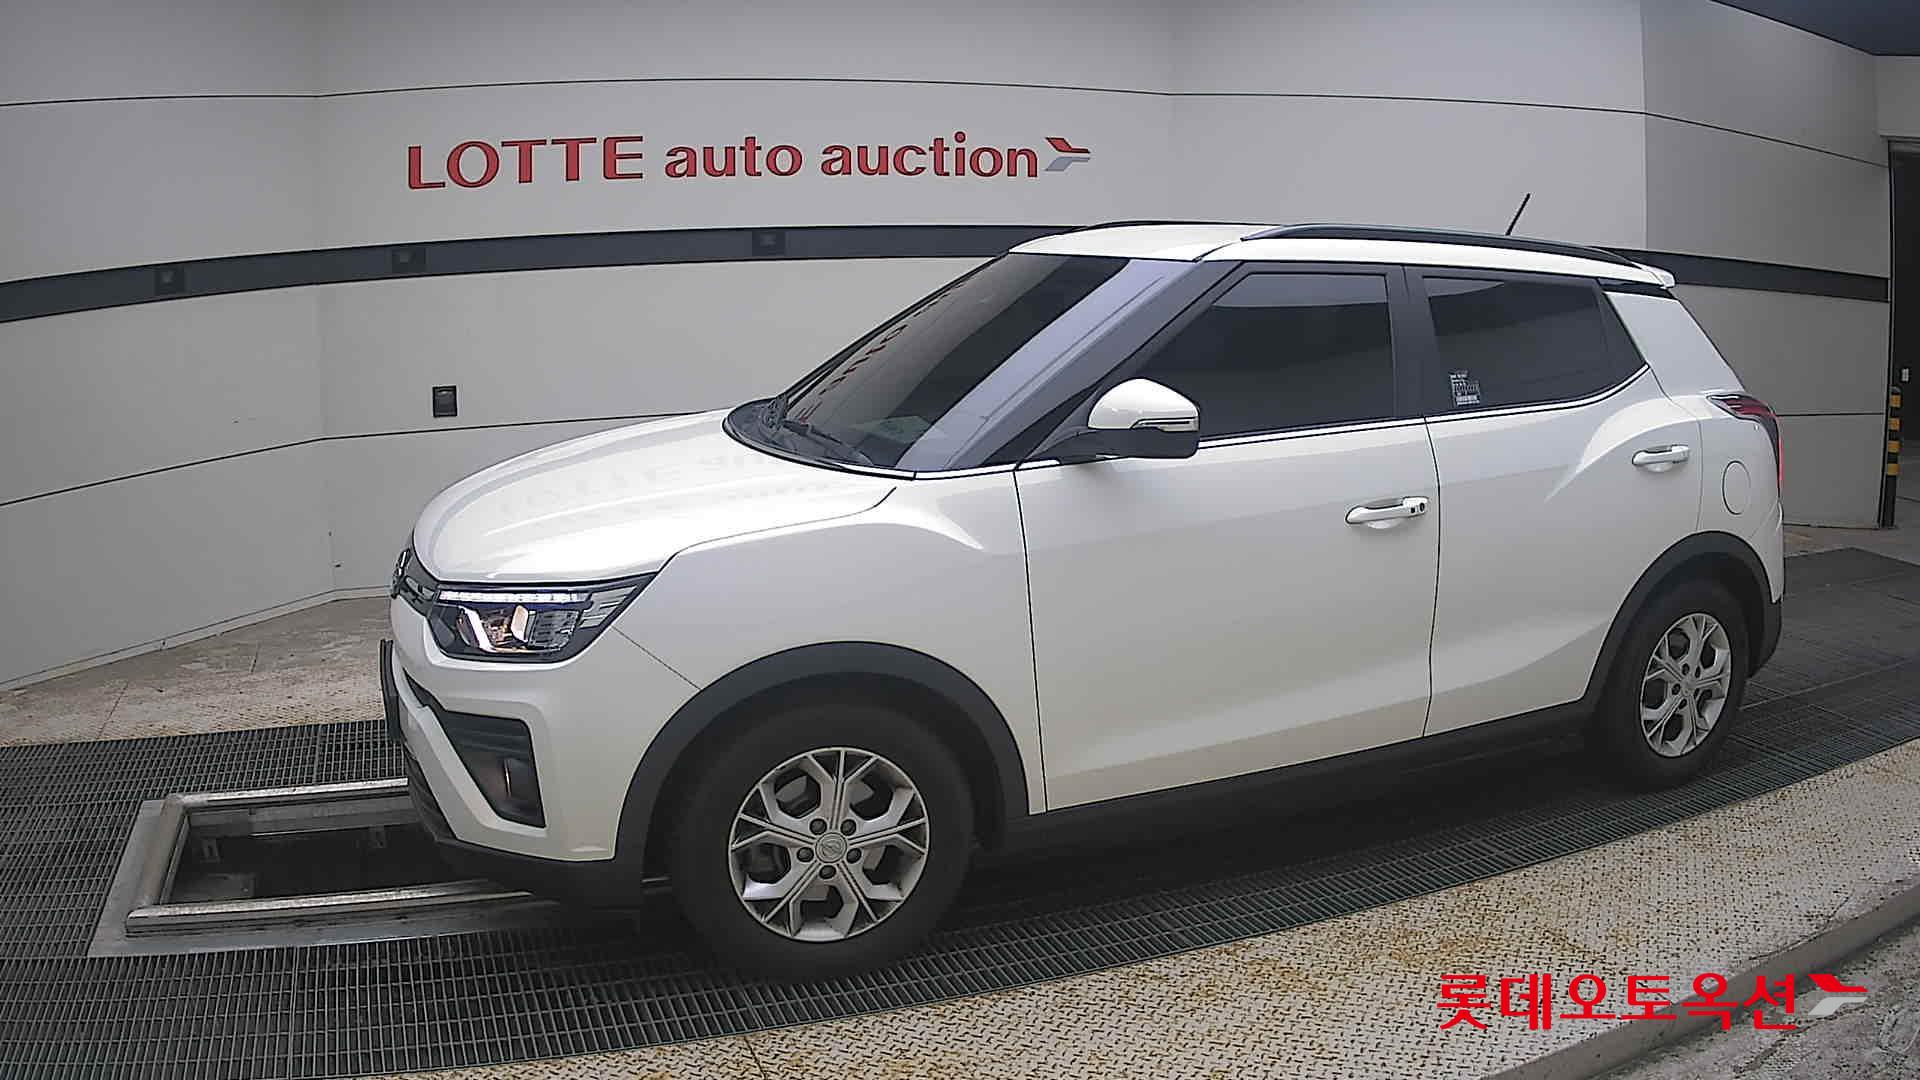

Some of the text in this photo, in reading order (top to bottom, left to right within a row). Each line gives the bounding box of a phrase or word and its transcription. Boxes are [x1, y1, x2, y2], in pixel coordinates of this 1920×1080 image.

[407, 131, 1039, 189] LOTTE auto auction
